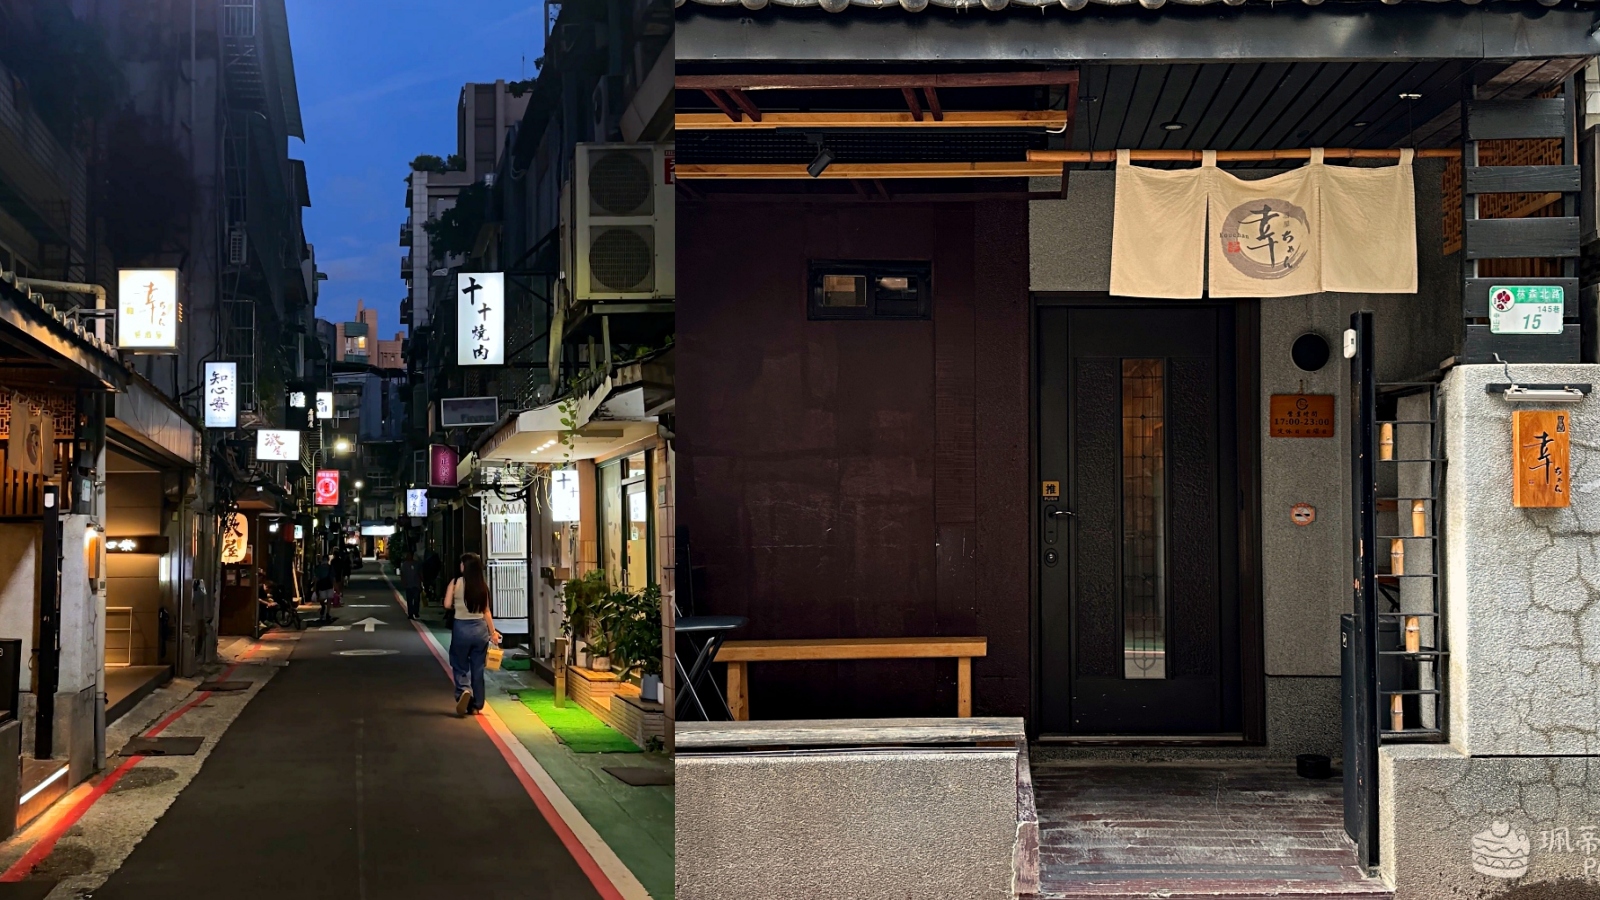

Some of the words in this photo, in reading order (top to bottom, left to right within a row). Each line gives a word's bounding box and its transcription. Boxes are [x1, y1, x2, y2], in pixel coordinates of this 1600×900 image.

[1516, 288, 1561, 301] 林森北路
[1537, 305, 1561, 314] 145巷
[1523, 314, 1543, 330] 15
[1274, 418, 1330, 426] 17:00-23:00
[1045, 483, 1057, 495] 推
